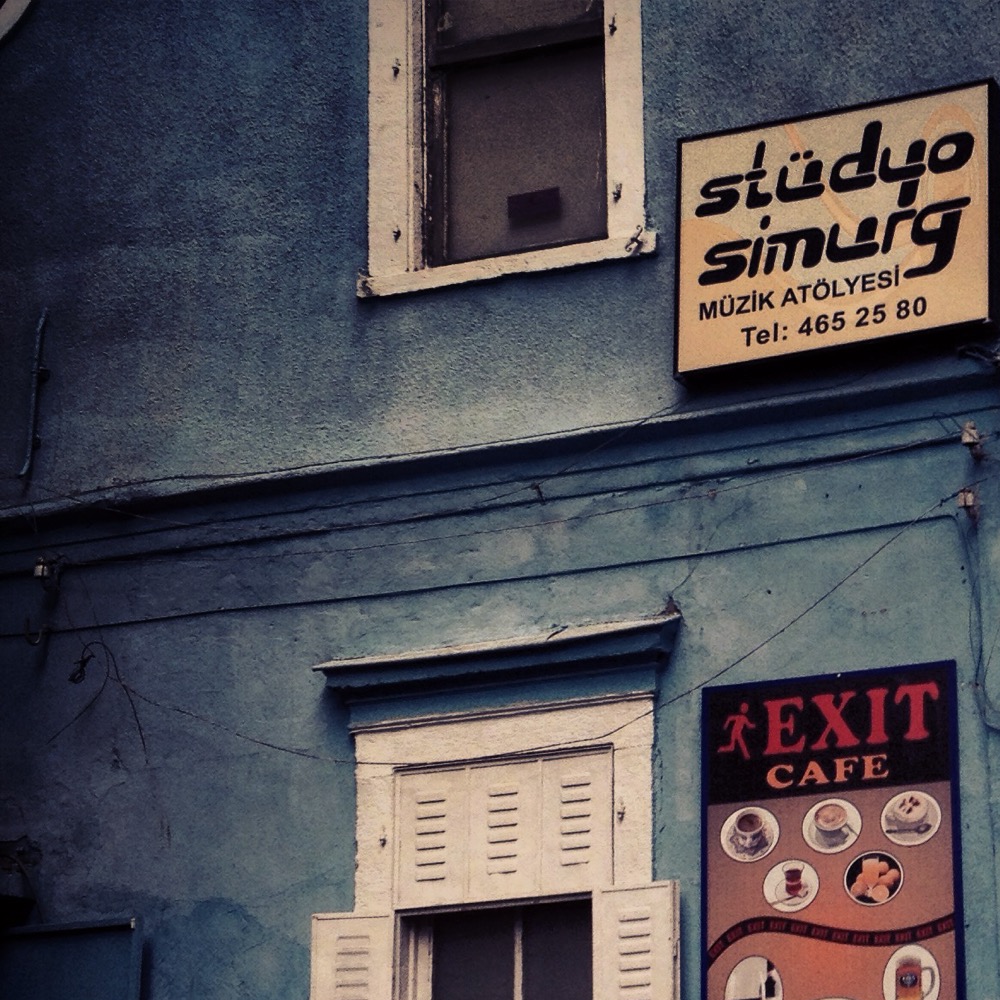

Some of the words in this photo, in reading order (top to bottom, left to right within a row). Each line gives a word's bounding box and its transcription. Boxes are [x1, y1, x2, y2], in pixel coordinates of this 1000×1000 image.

[695, 120, 974, 217] stüdyo
[698, 197, 971, 286] simurg
[698, 290, 775, 320] MÜZİK
[781, 265, 900, 308] ATÖLYESİ
[740, 322, 789, 347] Tel:
[797, 311, 846, 336] 465
[855, 303, 887, 327] 25
[896, 296, 927, 320] 80
[762, 681, 939, 756] EXIT
[766, 754, 890, 789] CAFE
